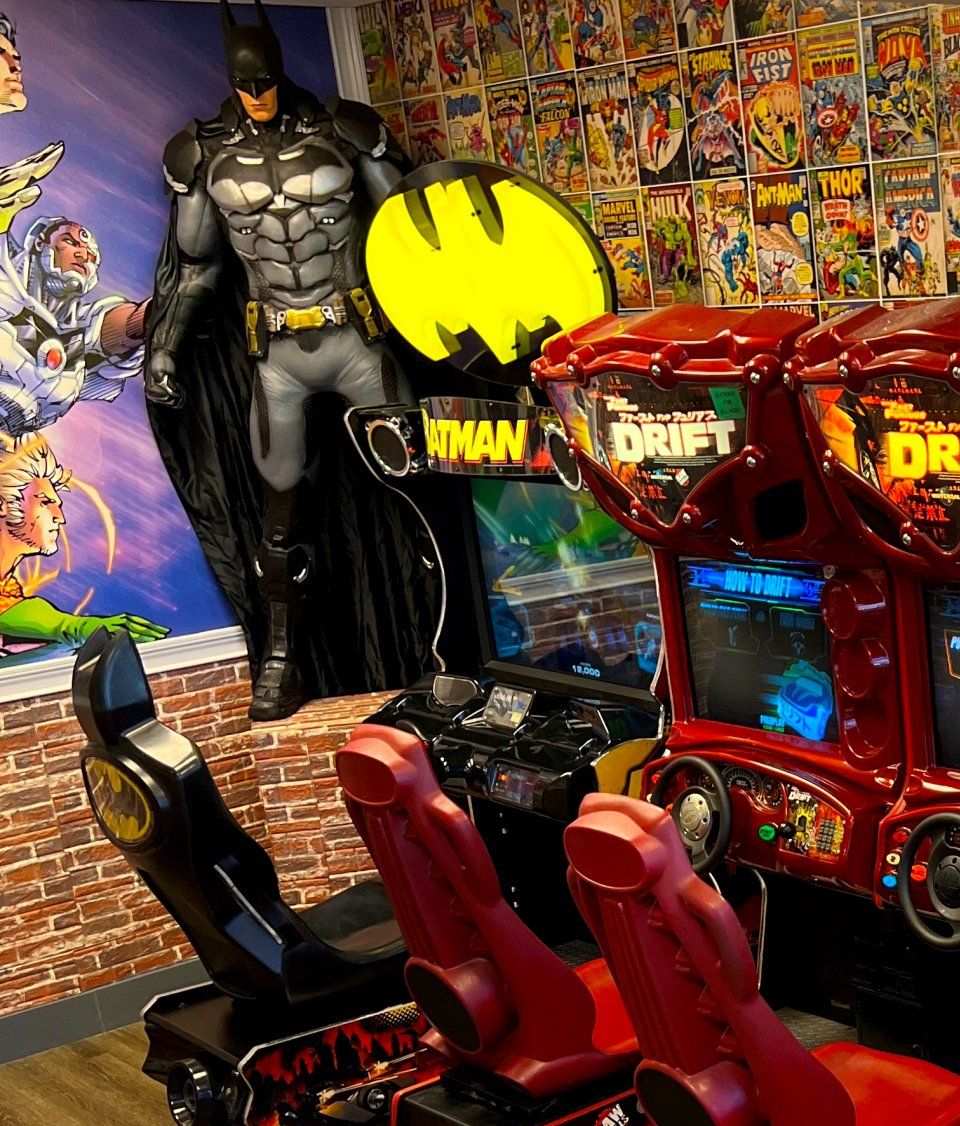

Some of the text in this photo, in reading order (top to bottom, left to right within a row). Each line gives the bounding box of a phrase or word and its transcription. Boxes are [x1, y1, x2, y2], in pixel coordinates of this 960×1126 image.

[691, 50, 733, 76] STRANGE
[750, 47, 793, 67] IRON
[751, 63, 792, 83] FIST
[539, 108, 570, 122] FALCON
[818, 168, 863, 198] THOR
[602, 200, 637, 215] MARVEL
[650, 187, 692, 221] HULK
[611, 420, 736, 463] DRIFT
[724, 569, 793, 598] HOW TO DRIFT
[572, 663, 601, 678] 12,000
